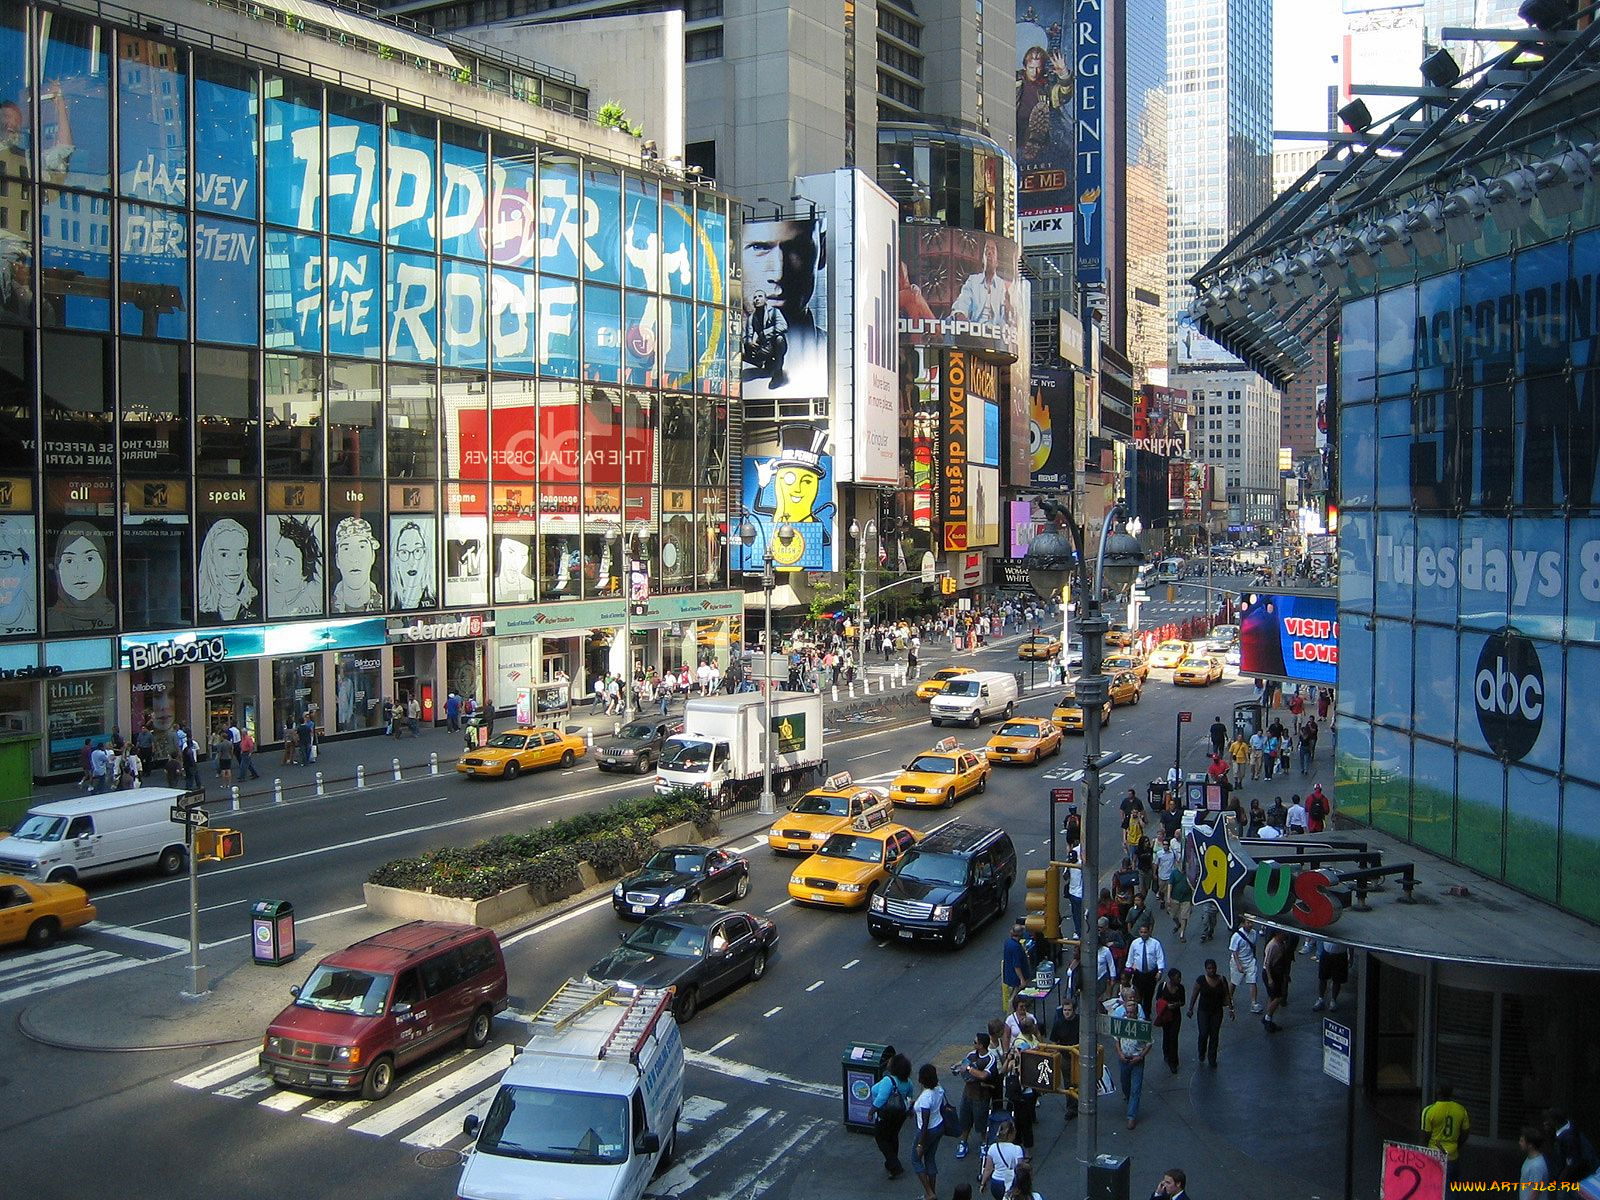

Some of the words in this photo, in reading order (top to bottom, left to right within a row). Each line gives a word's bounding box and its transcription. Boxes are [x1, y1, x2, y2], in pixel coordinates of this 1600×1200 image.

[132, 154, 249, 211] HARVEY
[291, 125, 605, 272] FIDDLER
[1040, 173, 1064, 188] ME
[124, 215, 255, 265] FIERSTEIN
[304, 255, 368, 289] ON
[296, 288, 375, 337] THE
[388, 265, 578, 366] ROOF
[1411, 272, 1600, 370] ACCORDIN
[949, 351, 966, 435] KODAK
[970, 356, 998, 400] Kodak
[1041, 379, 1056, 388] NYC
[71, 487, 89, 500] all
[209, 491, 247, 503] speak
[346, 492, 364, 502] the
[946, 441, 966, 516] digital
[540, 493, 578, 505] language
[447, 539, 485, 577] MTV
[408, 617, 471, 641] element
[1284, 617, 1331, 639] VISIT
[51, 680, 94, 699] think
[1475, 656, 1542, 722] abc
[1202, 845, 1228, 899] R
[1254, 861, 1333, 929] US
[1114, 1019, 1121, 1034] W
[1125, 1021, 1137, 1037] 44
[1140, 1023, 1148, 1031] ST
